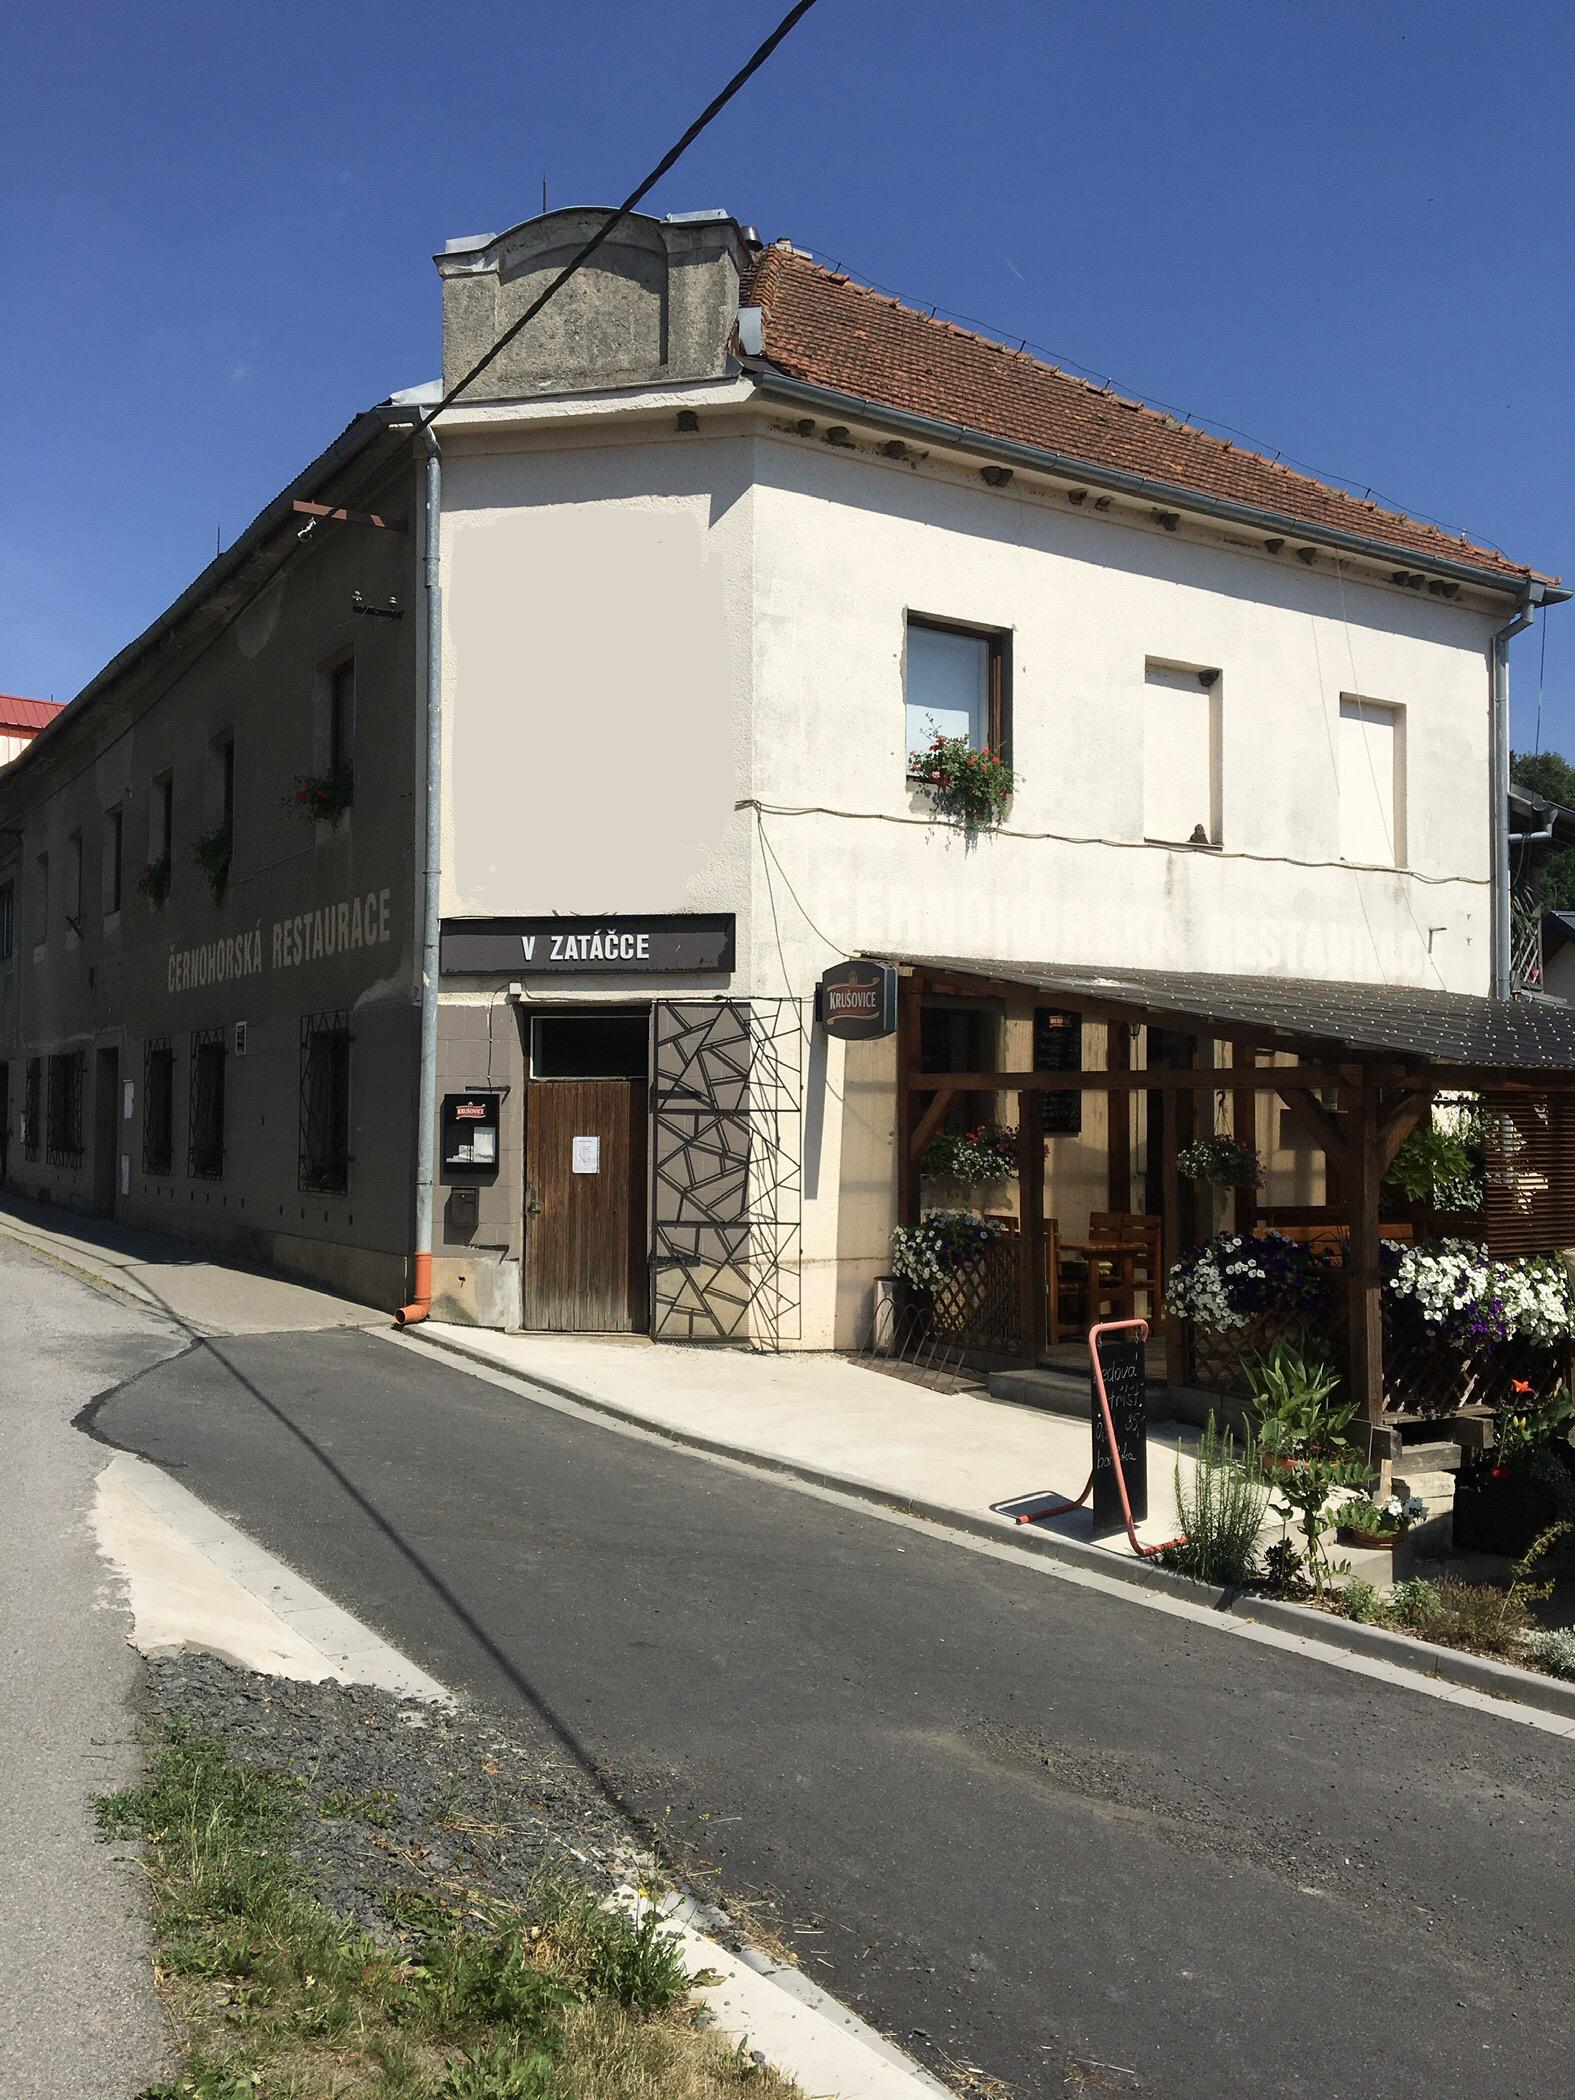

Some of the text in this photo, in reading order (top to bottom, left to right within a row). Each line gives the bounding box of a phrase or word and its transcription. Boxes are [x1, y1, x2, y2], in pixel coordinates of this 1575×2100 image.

[167, 887, 391, 993] ČERNOHORSKÁ RESTAURACE
[521, 928, 650, 961] V ZATÁČCE
